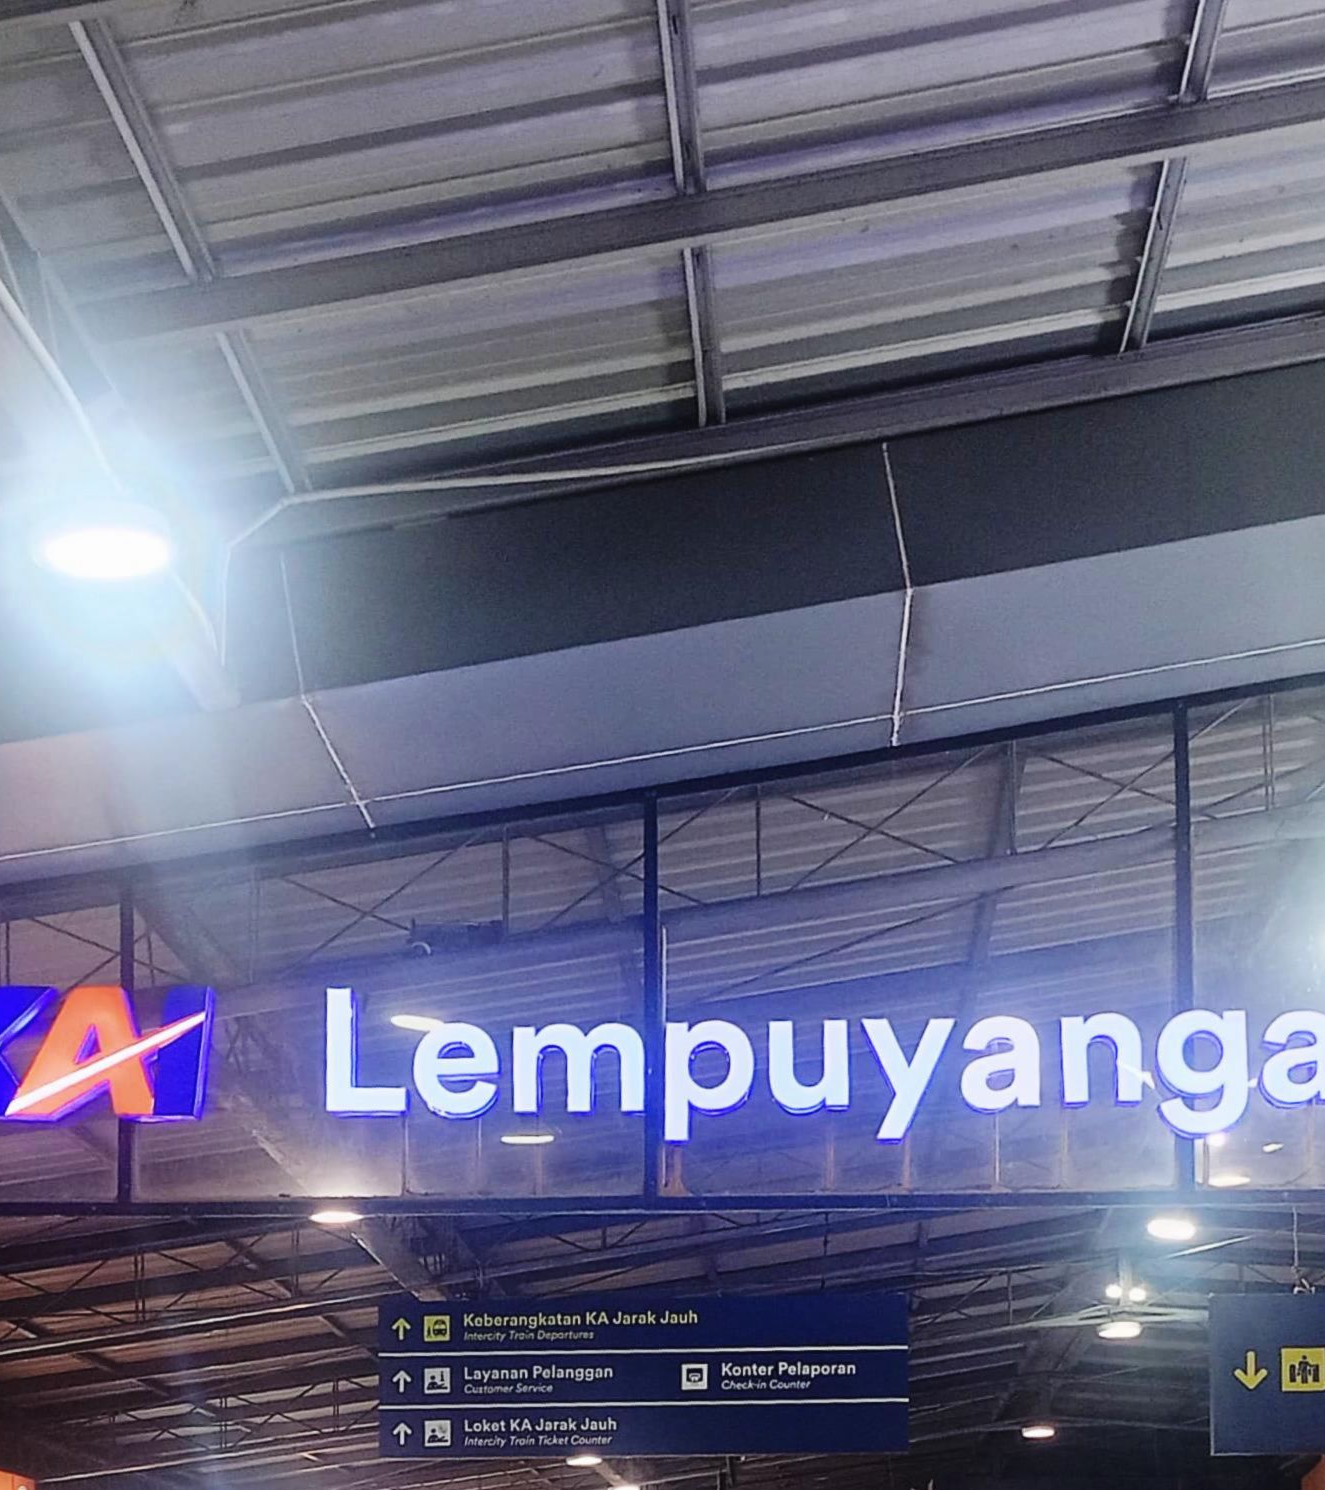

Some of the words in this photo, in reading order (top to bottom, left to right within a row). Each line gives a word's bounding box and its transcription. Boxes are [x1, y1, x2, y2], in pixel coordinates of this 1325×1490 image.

[463, 1313, 581, 1329] Keberangkatan
[585, 1312, 610, 1326] KA
[613, 1311, 656, 1325] Jarak
[660, 1310, 698, 1324] Jauh
[463, 1331, 506, 1342] Intercity
[509, 1330, 534, 1341] Train
[537, 1330, 594, 1341] Departures
[464, 1365, 528, 1383] Layanan
[533, 1364, 614, 1381] Pelanggan
[721, 1362, 774, 1376] Konter
[778, 1361, 856, 1378] Pelaporan
[464, 1384, 514, 1394] Customer
[515, 1382, 554, 1393] Service
[721, 1379, 767, 1390] Check-in
[769, 1379, 811, 1389] Counter
[464, 1419, 506, 1432] Loket
[510, 1418, 533, 1431] KA
[535, 1417, 577, 1431] Jarak
[580, 1417, 617, 1431] Jauh
[464, 1436, 507, 1448] Intercity
[509, 1435, 535, 1446] Train
[538, 1434, 568, 1445] Ticket
[571, 1434, 613, 1445] Counter
